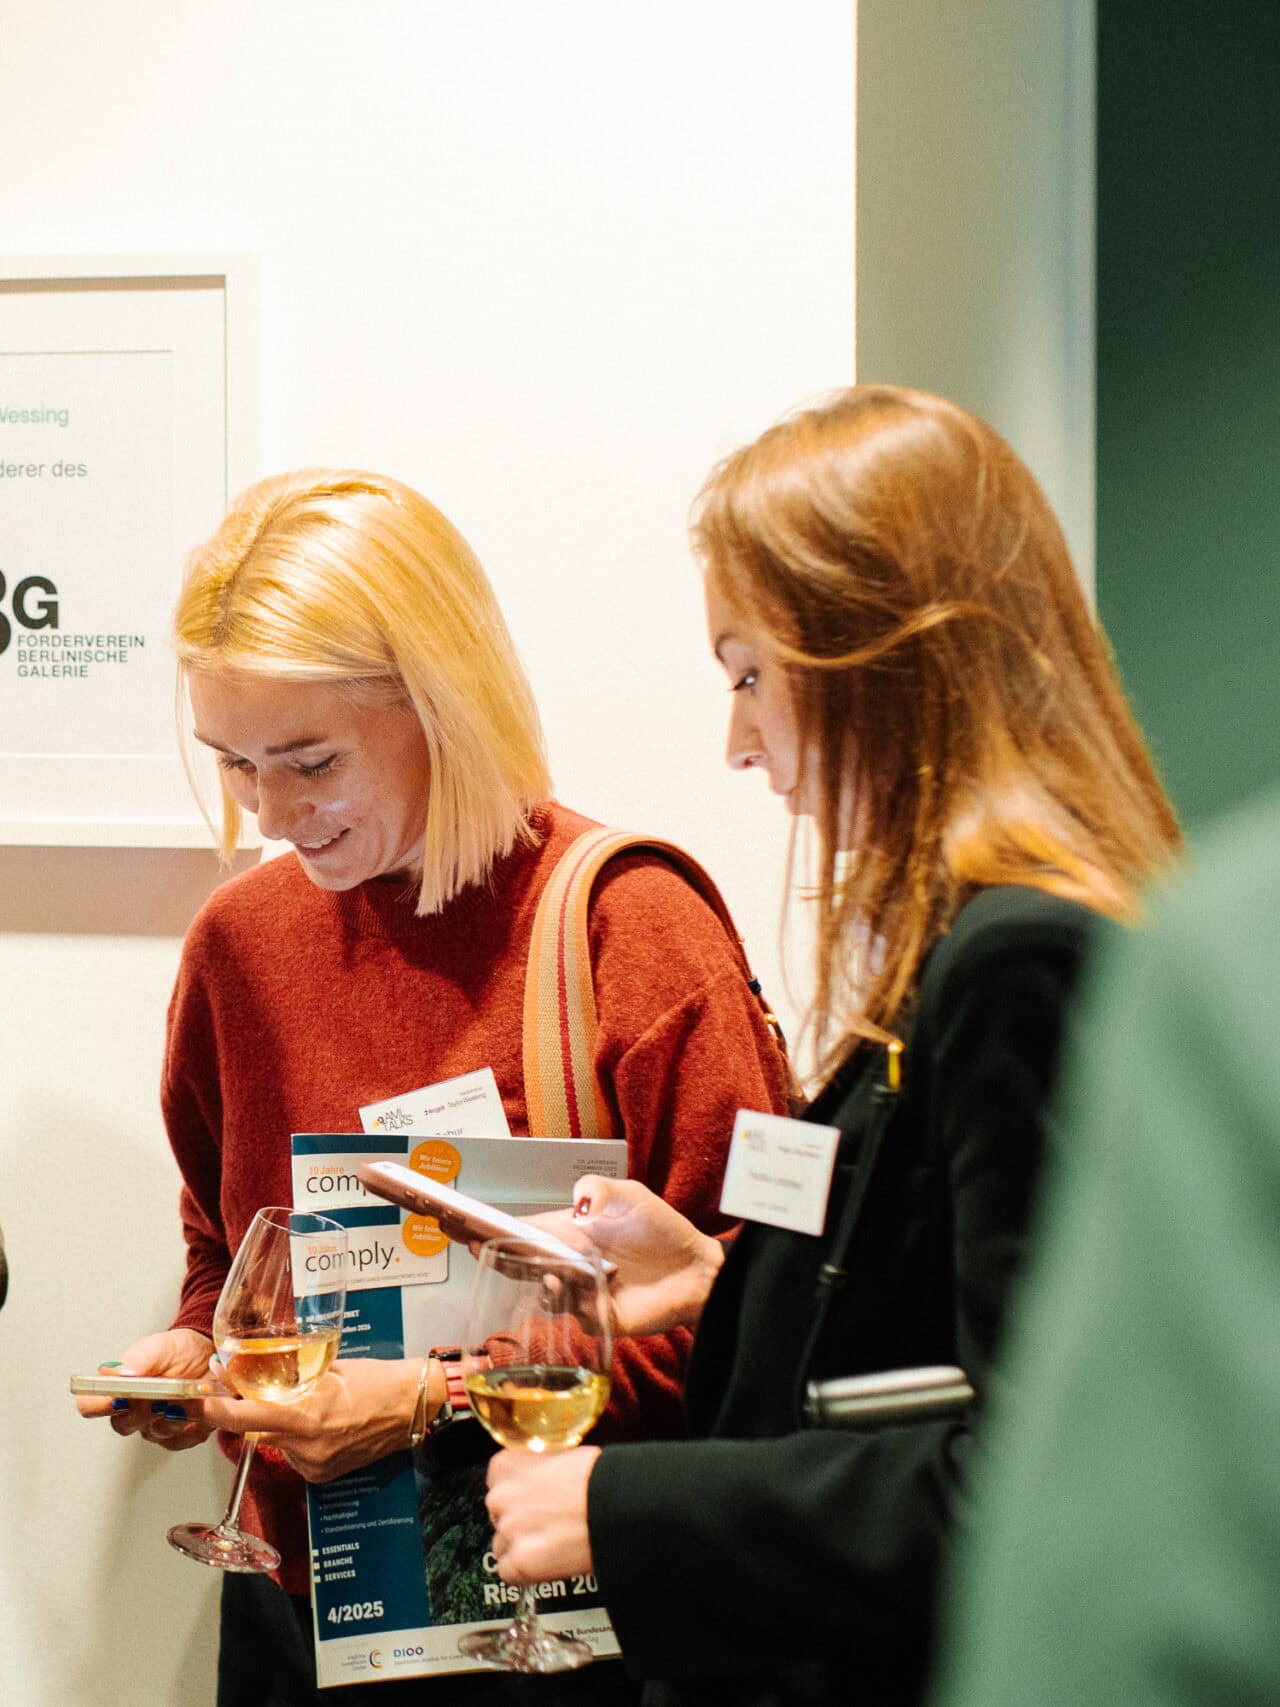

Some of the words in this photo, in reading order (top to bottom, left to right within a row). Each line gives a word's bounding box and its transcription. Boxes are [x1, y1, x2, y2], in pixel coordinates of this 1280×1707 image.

[51, 459, 88, 478] des
[17, 650, 129, 663] BERLINISCHE
[17, 665, 89, 678] GALERIE
[383, 1114, 414, 1131] TALKS
[320, 1166, 345, 1174] Jahre
[306, 1174, 367, 1197] com
[305, 1241, 401, 1272] comply.
[322, 1542, 360, 1555] ESSENTIALS
[323, 1556, 353, 1568] BRANCHE
[324, 1569, 356, 1582] SERVICES
[483, 1579, 567, 1605] Risken
[571, 1574, 599, 1595] 20
[327, 1600, 385, 1624] 4/2025
